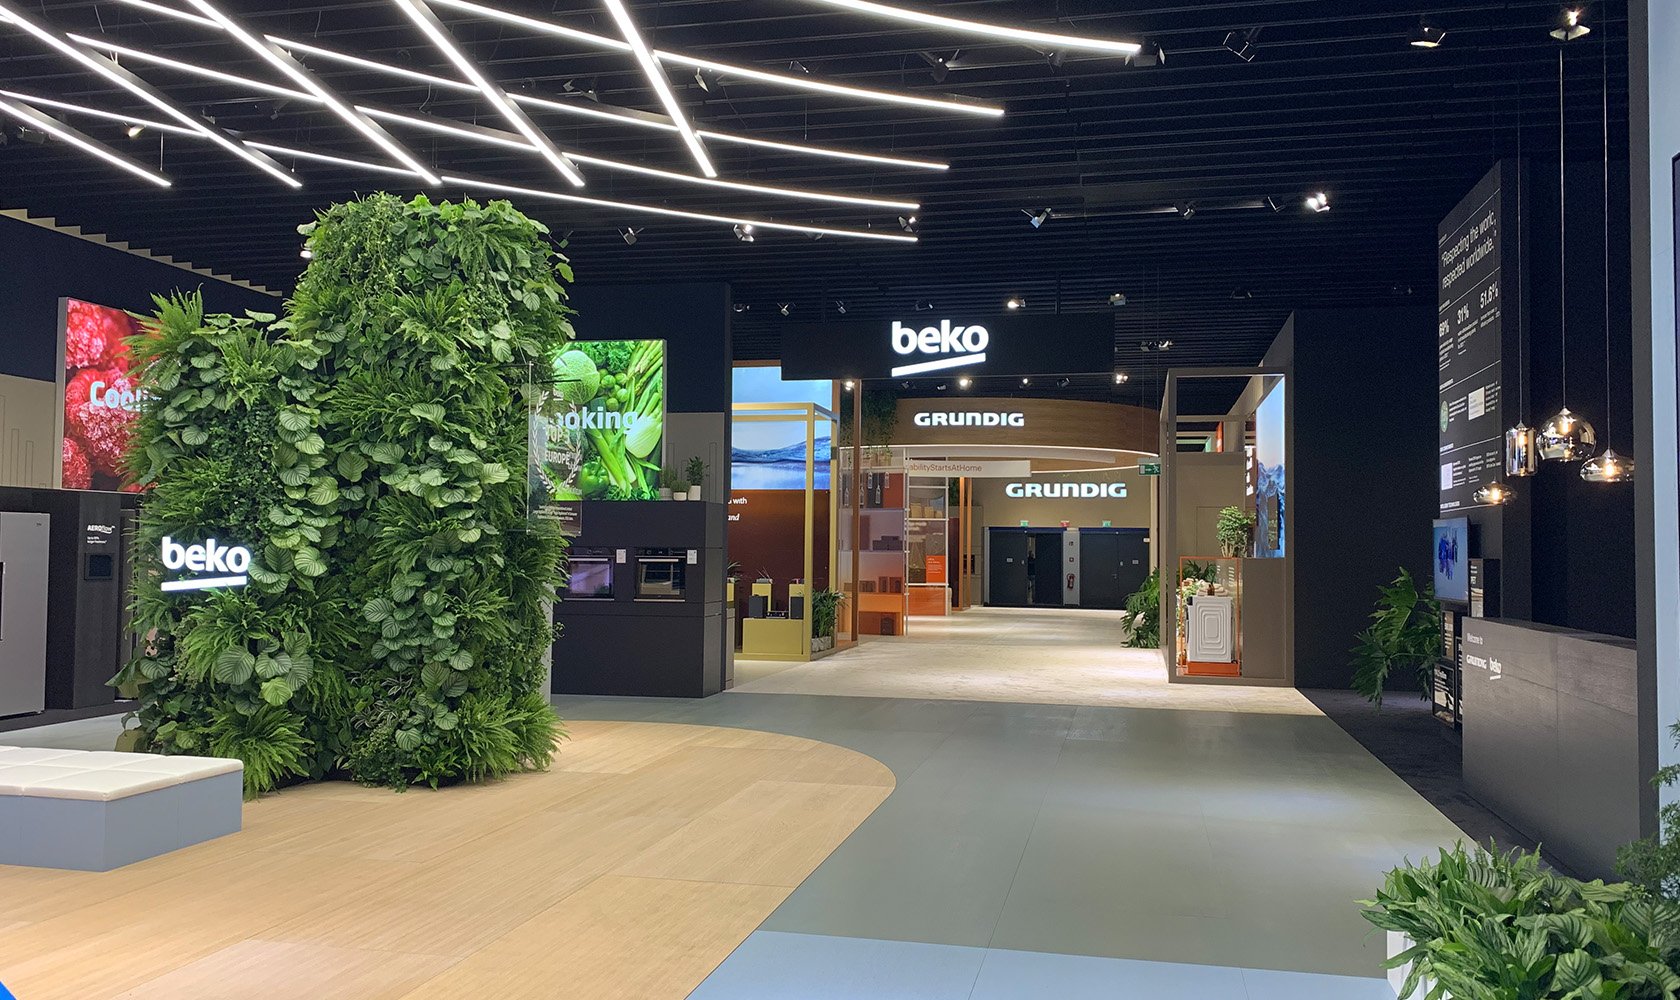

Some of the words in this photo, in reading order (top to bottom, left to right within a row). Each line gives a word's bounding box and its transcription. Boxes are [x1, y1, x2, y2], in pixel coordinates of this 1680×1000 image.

[1457, 303, 1470, 325] 31%
[891, 319, 990, 355] beko
[554, 406, 639, 436] ooking
[913, 412, 1025, 427] GRUNDIG
[1005, 482, 1127, 498] GRUNDIG
[161, 536, 251, 573] beko
[1466, 654, 1487, 670] GRUNDIG
[1489, 657, 1502, 674] beko
